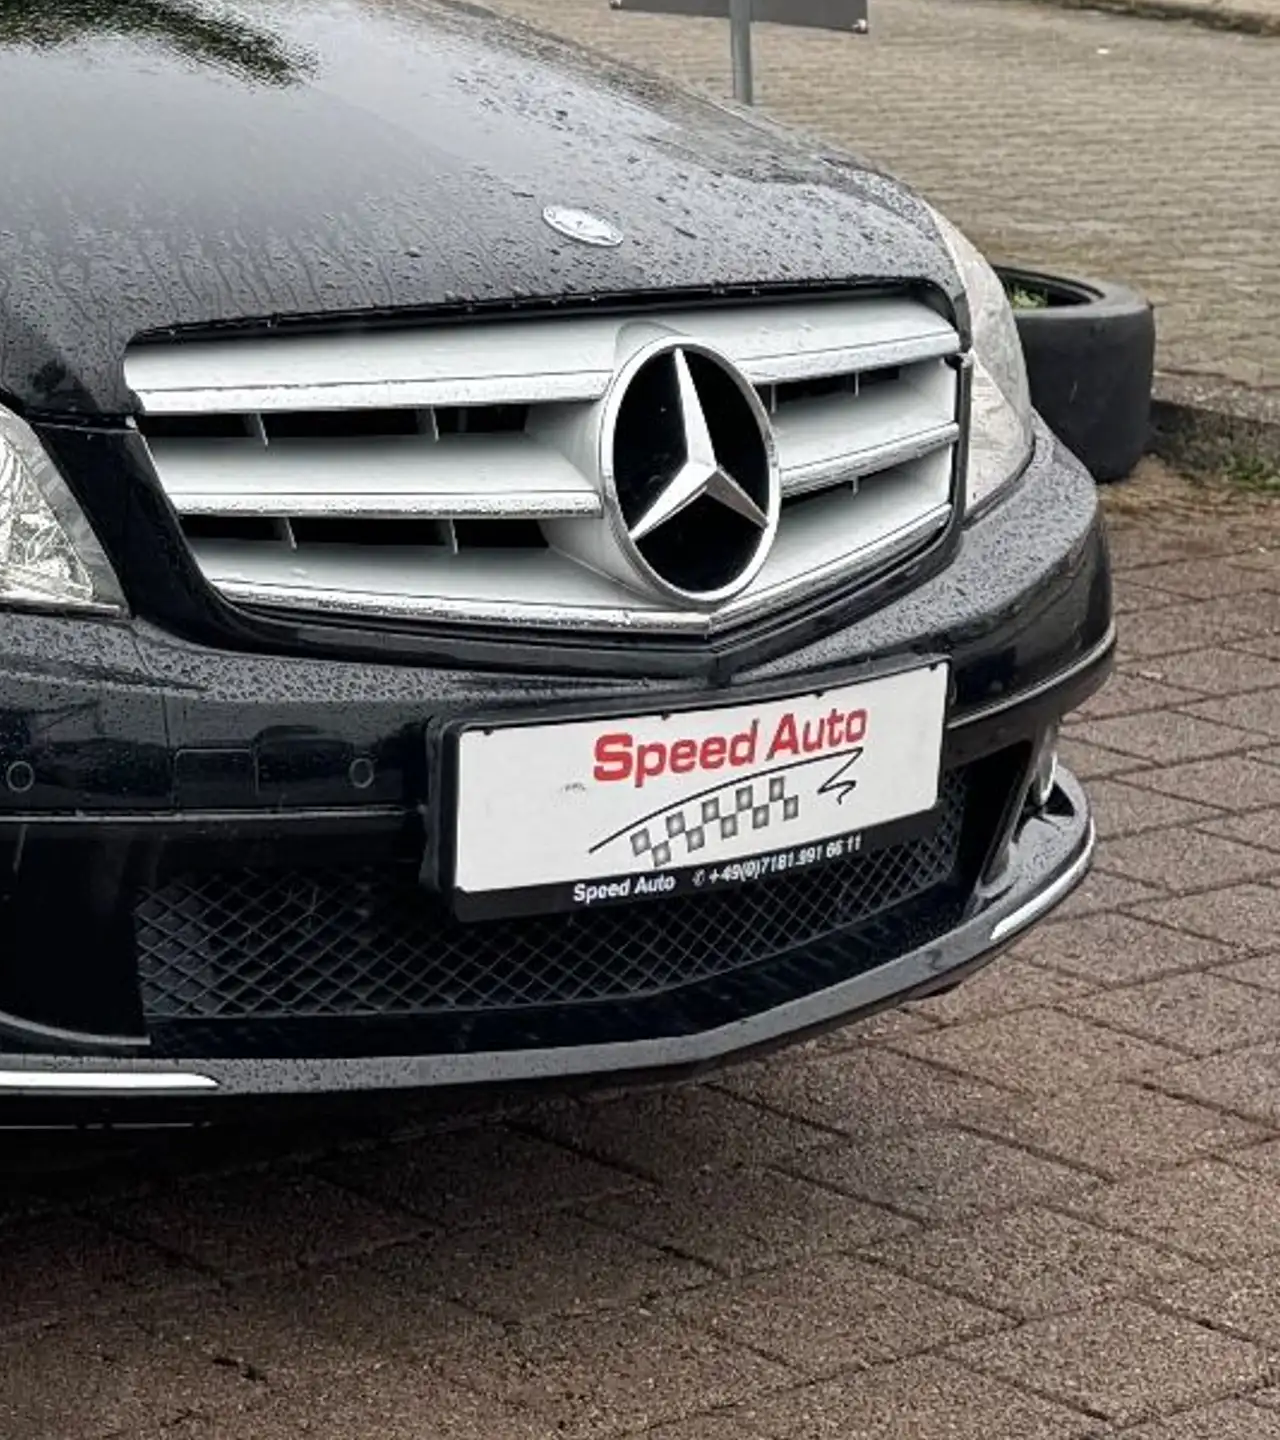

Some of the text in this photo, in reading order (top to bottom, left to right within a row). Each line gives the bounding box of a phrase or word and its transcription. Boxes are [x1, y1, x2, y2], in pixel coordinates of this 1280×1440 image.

[592, 708, 868, 787] Speed Auto
[572, 880, 631, 905] Speed
[633, 873, 677, 895] Auto
